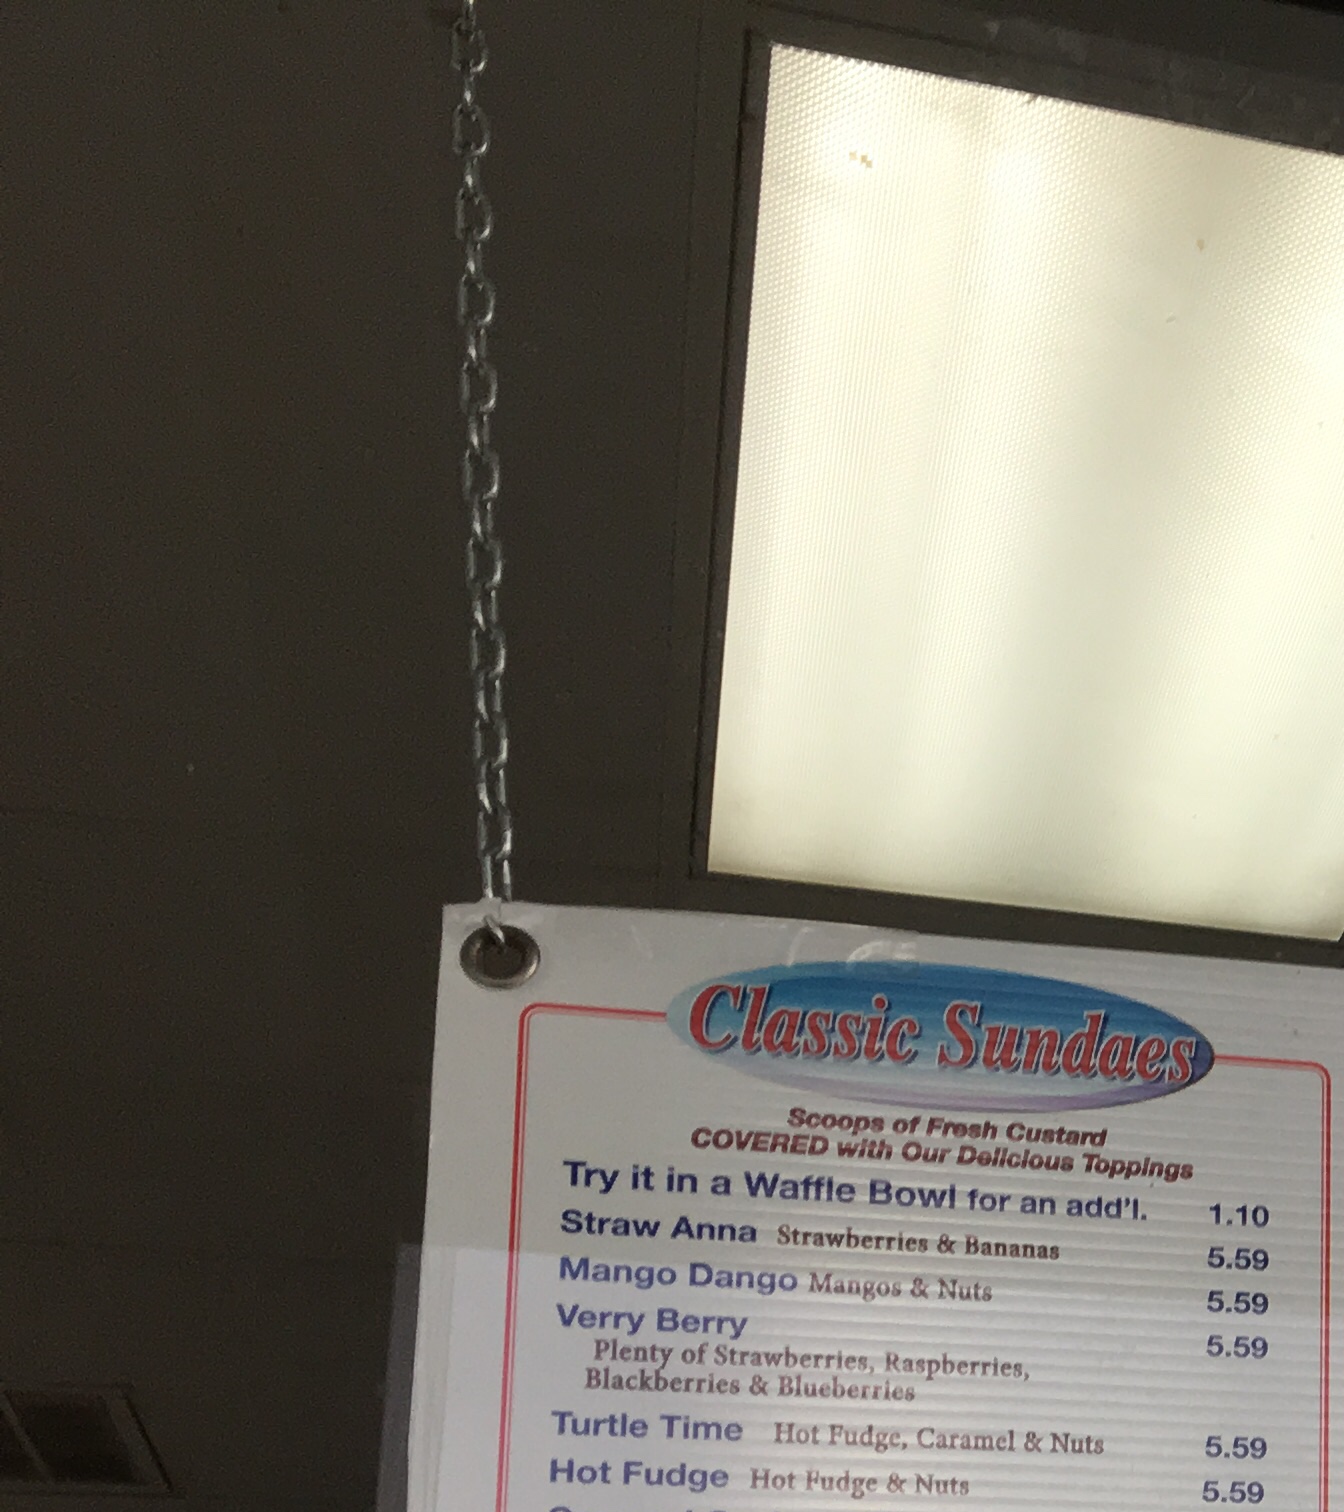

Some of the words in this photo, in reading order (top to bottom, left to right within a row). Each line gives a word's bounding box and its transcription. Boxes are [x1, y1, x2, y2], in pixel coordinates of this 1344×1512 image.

[688, 981, 919, 1067] Classic
[937, 1000, 1198, 1087] Sundaes
[787, 1107, 884, 1136] Scoops
[892, 1116, 921, 1134] of
[926, 1117, 998, 1139] Fresh
[1006, 1123, 1107, 1147] Custard
[563, 1161, 619, 1194] Try
[632, 1165, 654, 1191] it
[667, 1167, 697, 1193] in
[711, 1176, 731, 1196] a
[744, 1171, 855, 1203] Waffle
[869, 1179, 956, 1209] Bowl
[967, 1189, 1011, 1212] for
[1020, 1196, 1056, 1215] an
[1067, 1197, 1146, 1220] add'l.
[1210, 1204, 1269, 1227] 1.10
[561, 1209, 660, 1237] Straw
[671, 1216, 756, 1242] Anna
[777, 1224, 928, 1252] Strawberries
[937, 1234, 956, 1254] &
[965, 1236, 1059, 1260] Bananas
[1208, 1247, 1269, 1271] 5.59
[551, 1411, 648, 1438] Turtle
[660, 1414, 743, 1441] Time
